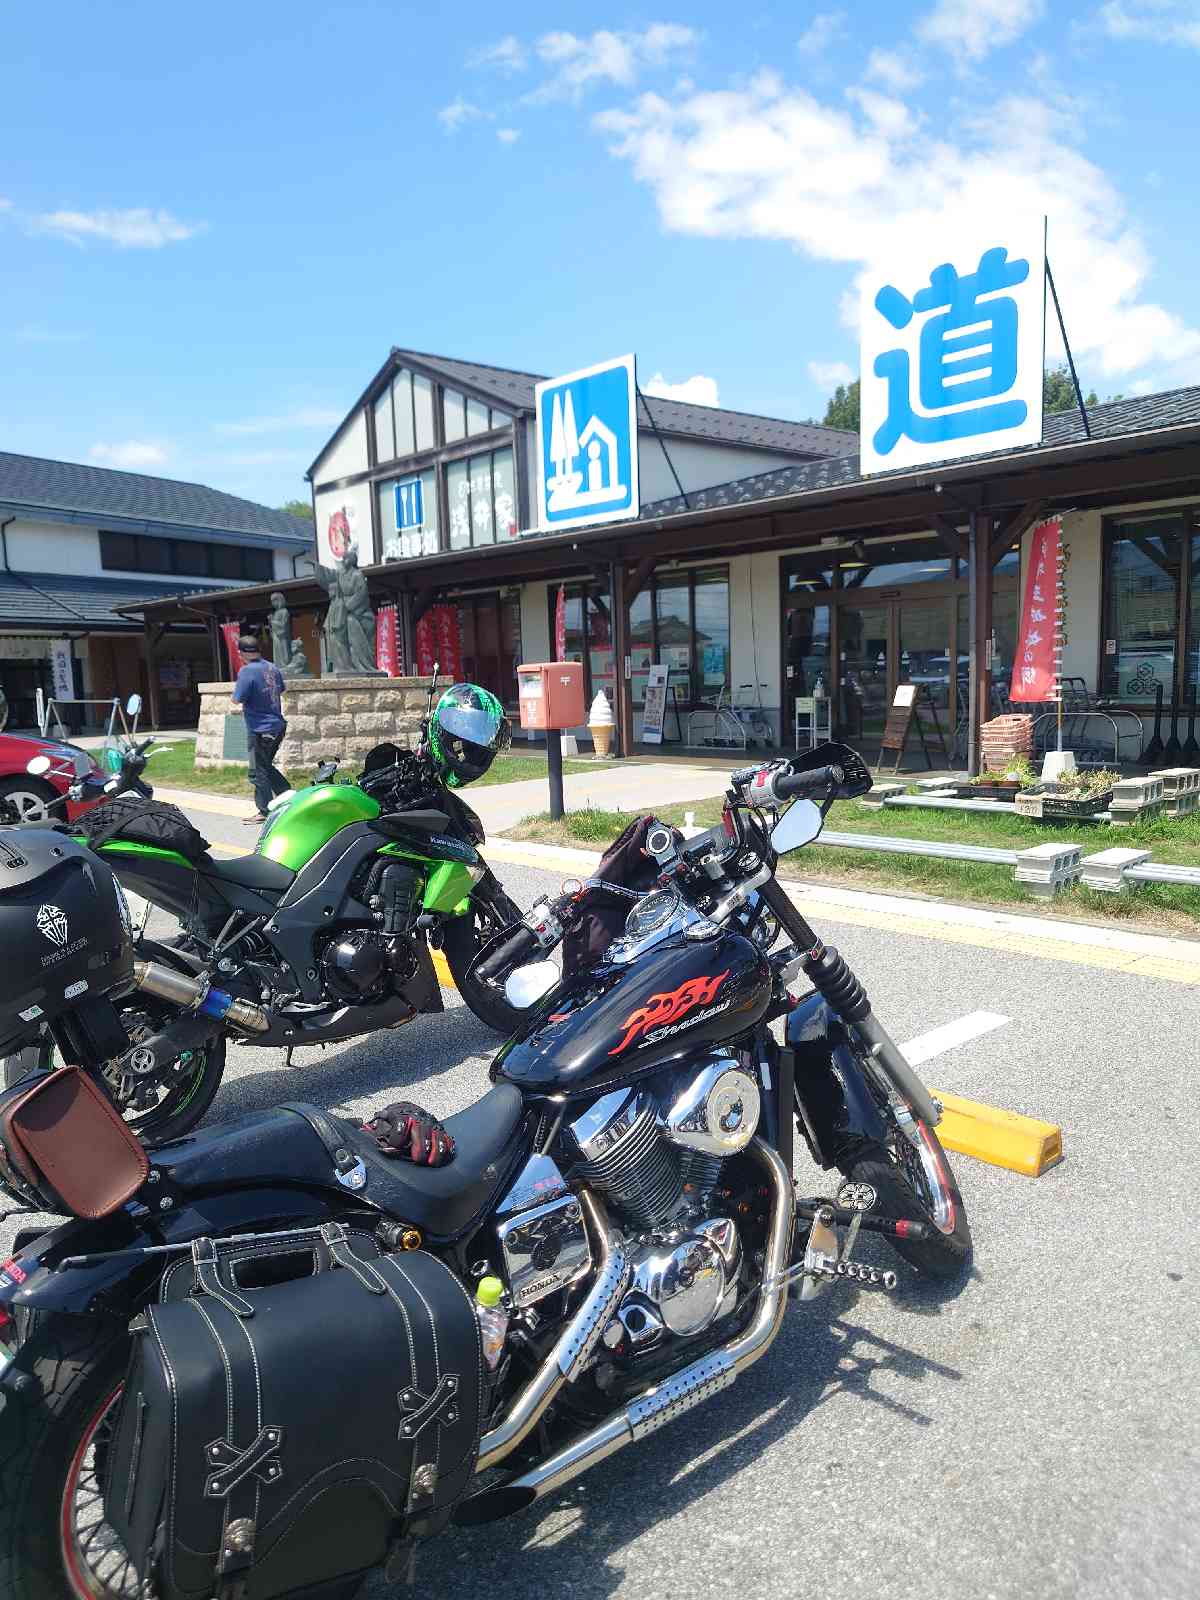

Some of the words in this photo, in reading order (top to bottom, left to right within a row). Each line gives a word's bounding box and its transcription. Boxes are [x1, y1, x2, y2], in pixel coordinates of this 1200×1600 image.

[873, 246, 1030, 456] 道
[638, 1000, 731, 1049] Shadow
[520, 1273, 562, 1298] HONDA
